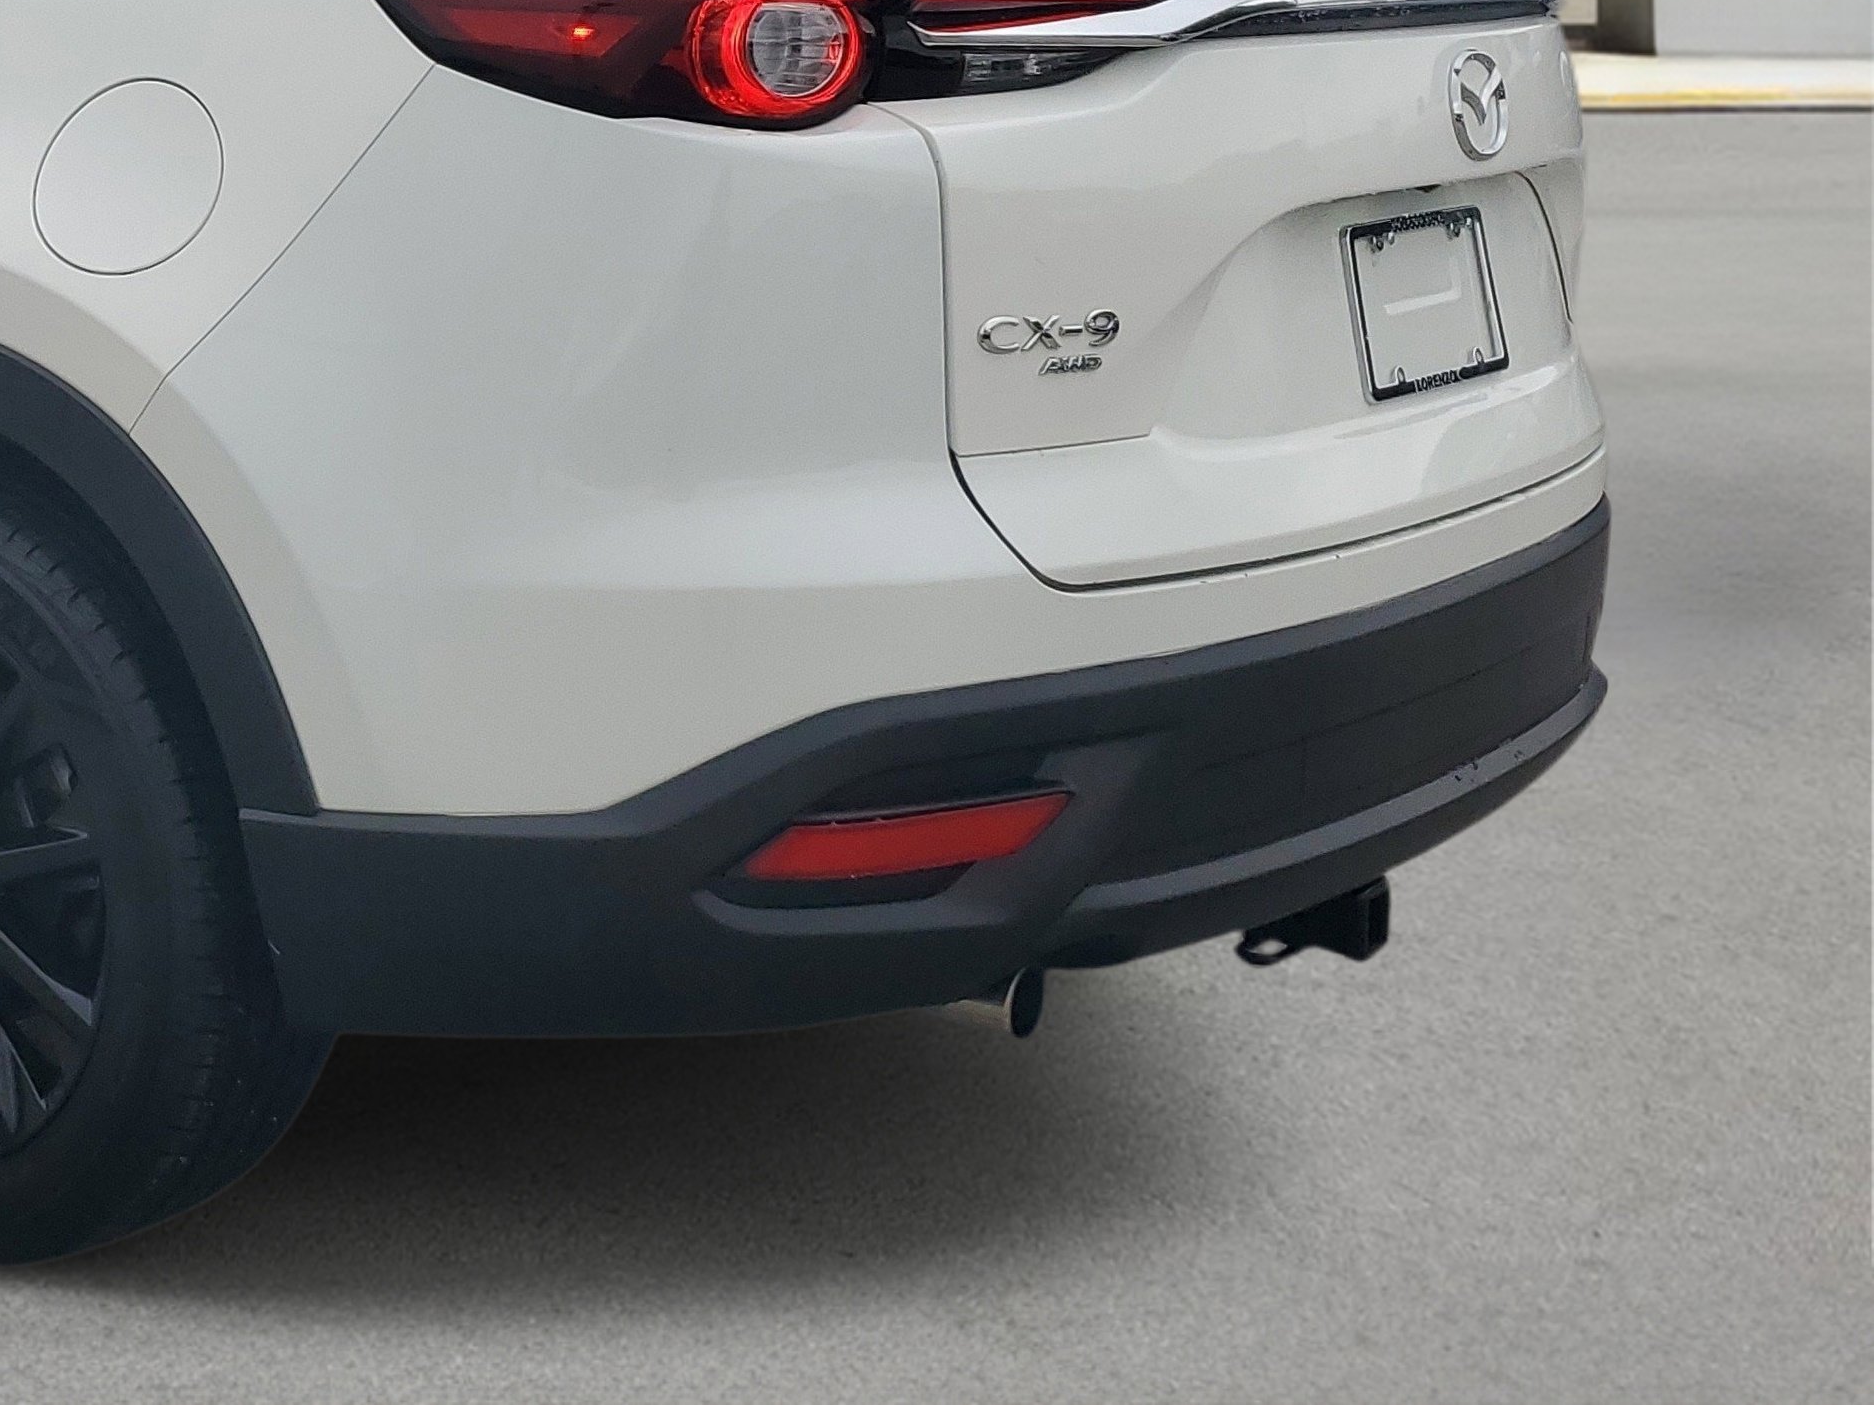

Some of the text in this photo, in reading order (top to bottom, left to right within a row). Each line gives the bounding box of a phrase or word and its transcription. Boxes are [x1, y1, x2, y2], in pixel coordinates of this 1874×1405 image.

[977, 308, 1120, 354] CX-9
[1038, 354, 1103, 376] AWD
[1414, 369, 1461, 392] LORENZO
